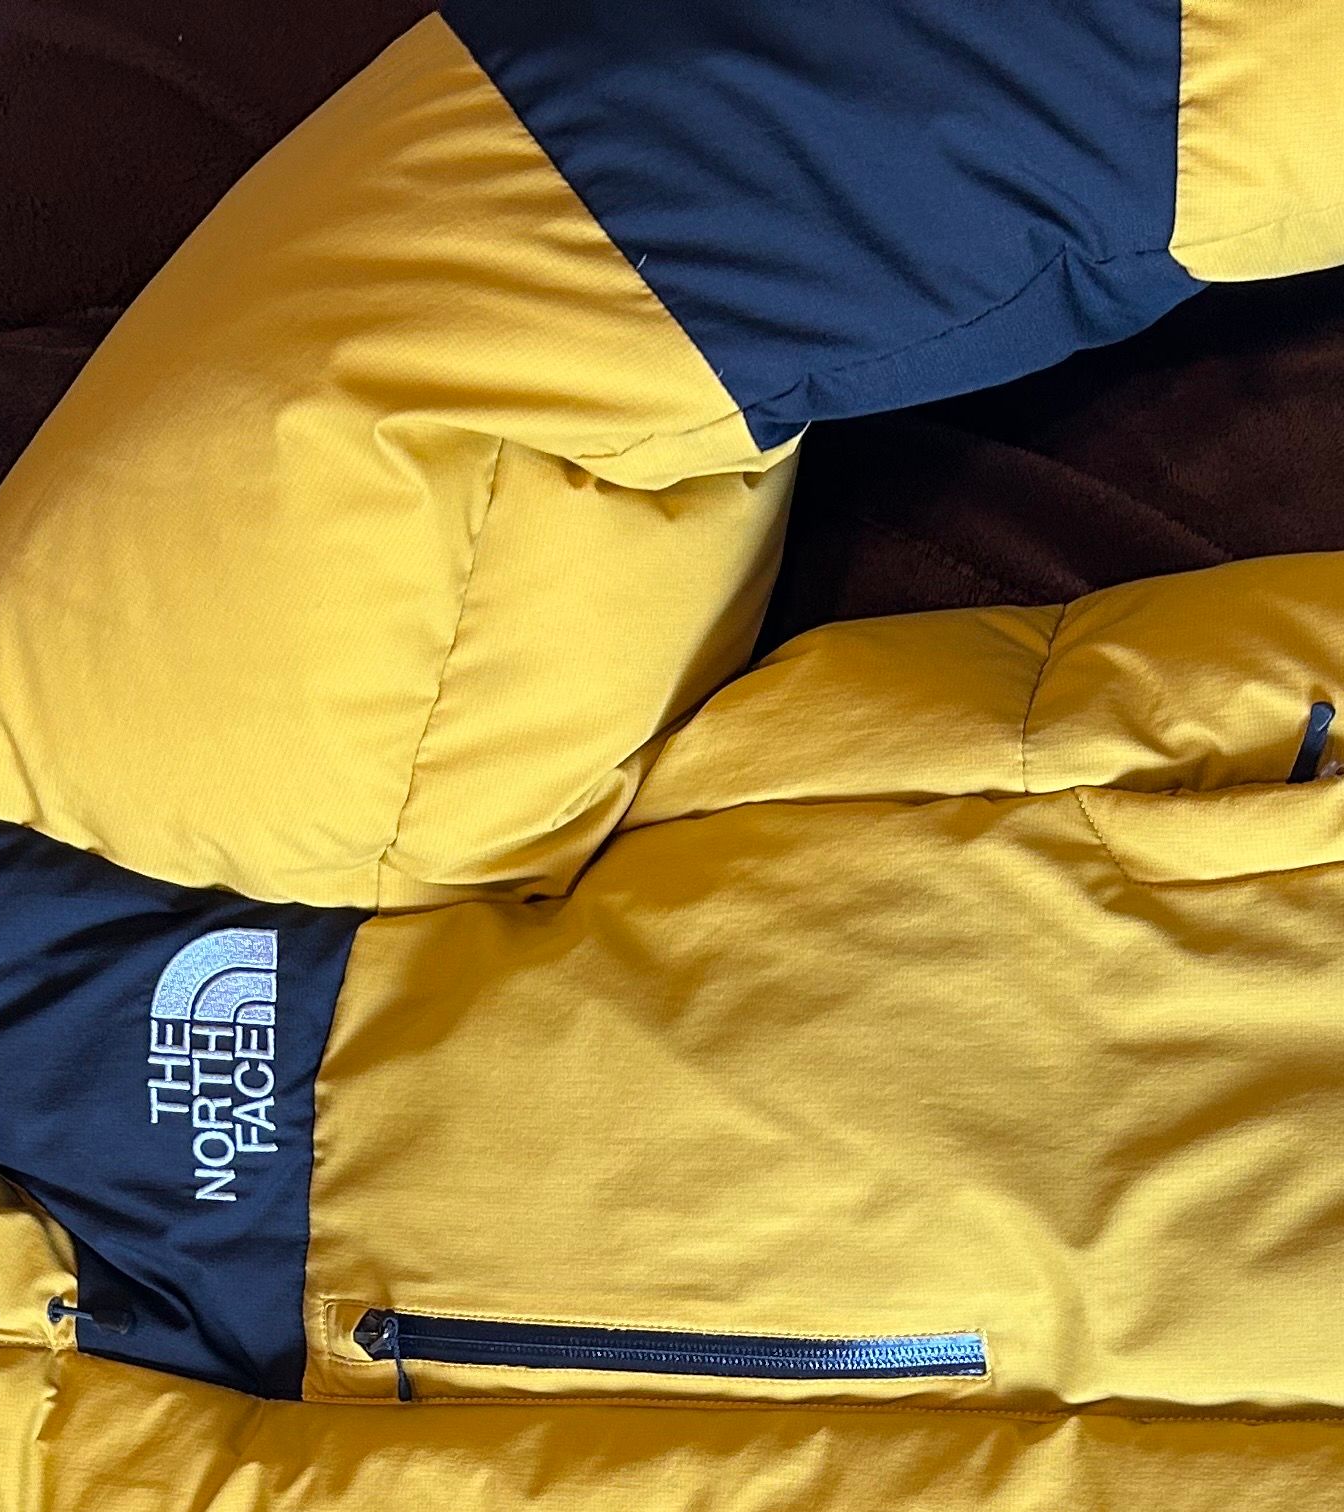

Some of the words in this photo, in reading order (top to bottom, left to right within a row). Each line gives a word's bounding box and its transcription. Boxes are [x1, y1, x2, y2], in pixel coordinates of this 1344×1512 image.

[147, 1019, 190, 1123] THE
[192, 1024, 236, 1201] NORTH
[232, 1025, 278, 1152] FACE
